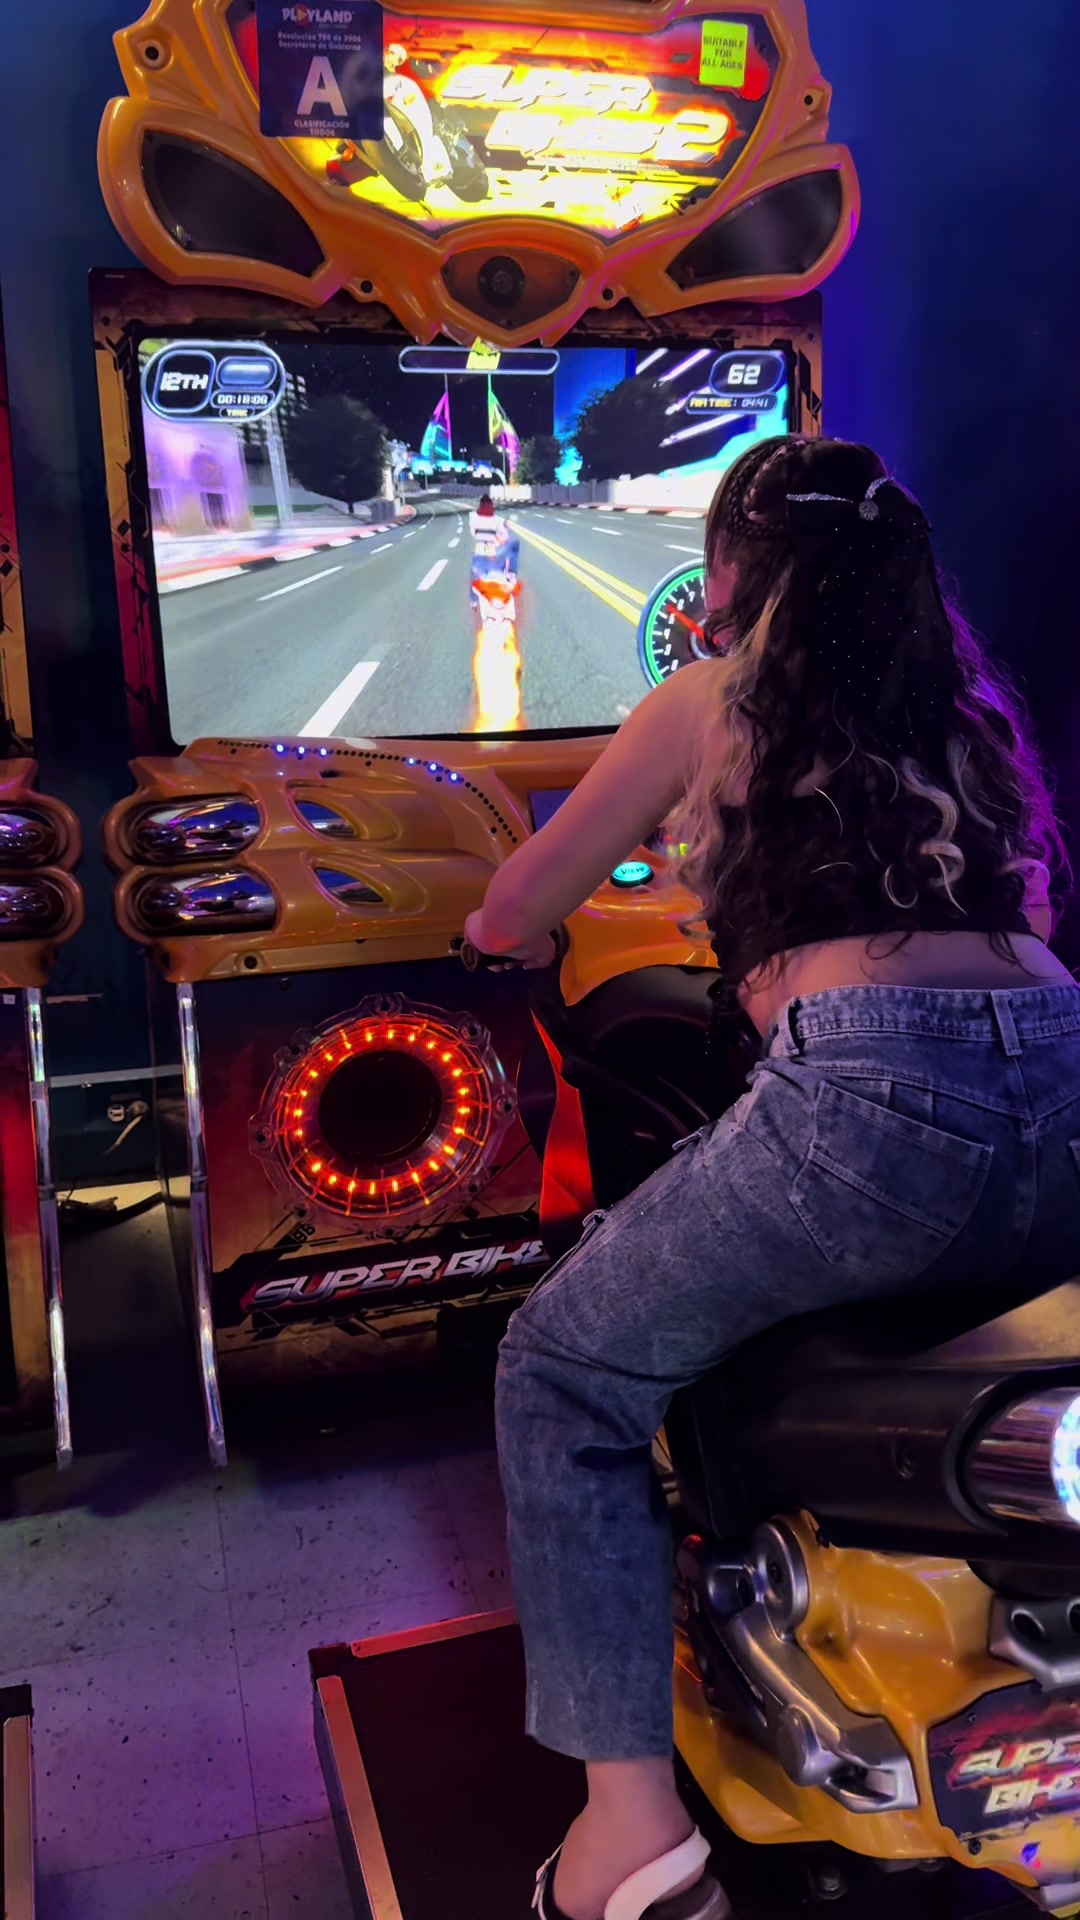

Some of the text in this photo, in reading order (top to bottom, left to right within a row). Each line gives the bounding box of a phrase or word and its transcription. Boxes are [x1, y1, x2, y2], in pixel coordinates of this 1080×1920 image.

[703, 36, 744, 48] SUITABLE
[715, 49, 732, 57] FOR
[702, 58, 743, 69] ALL AGES
[297, 56, 348, 117] A
[160, 372, 209, 391] 12TH
[727, 364, 761, 385] 62
[254, 1255, 441, 1301] SUPER
